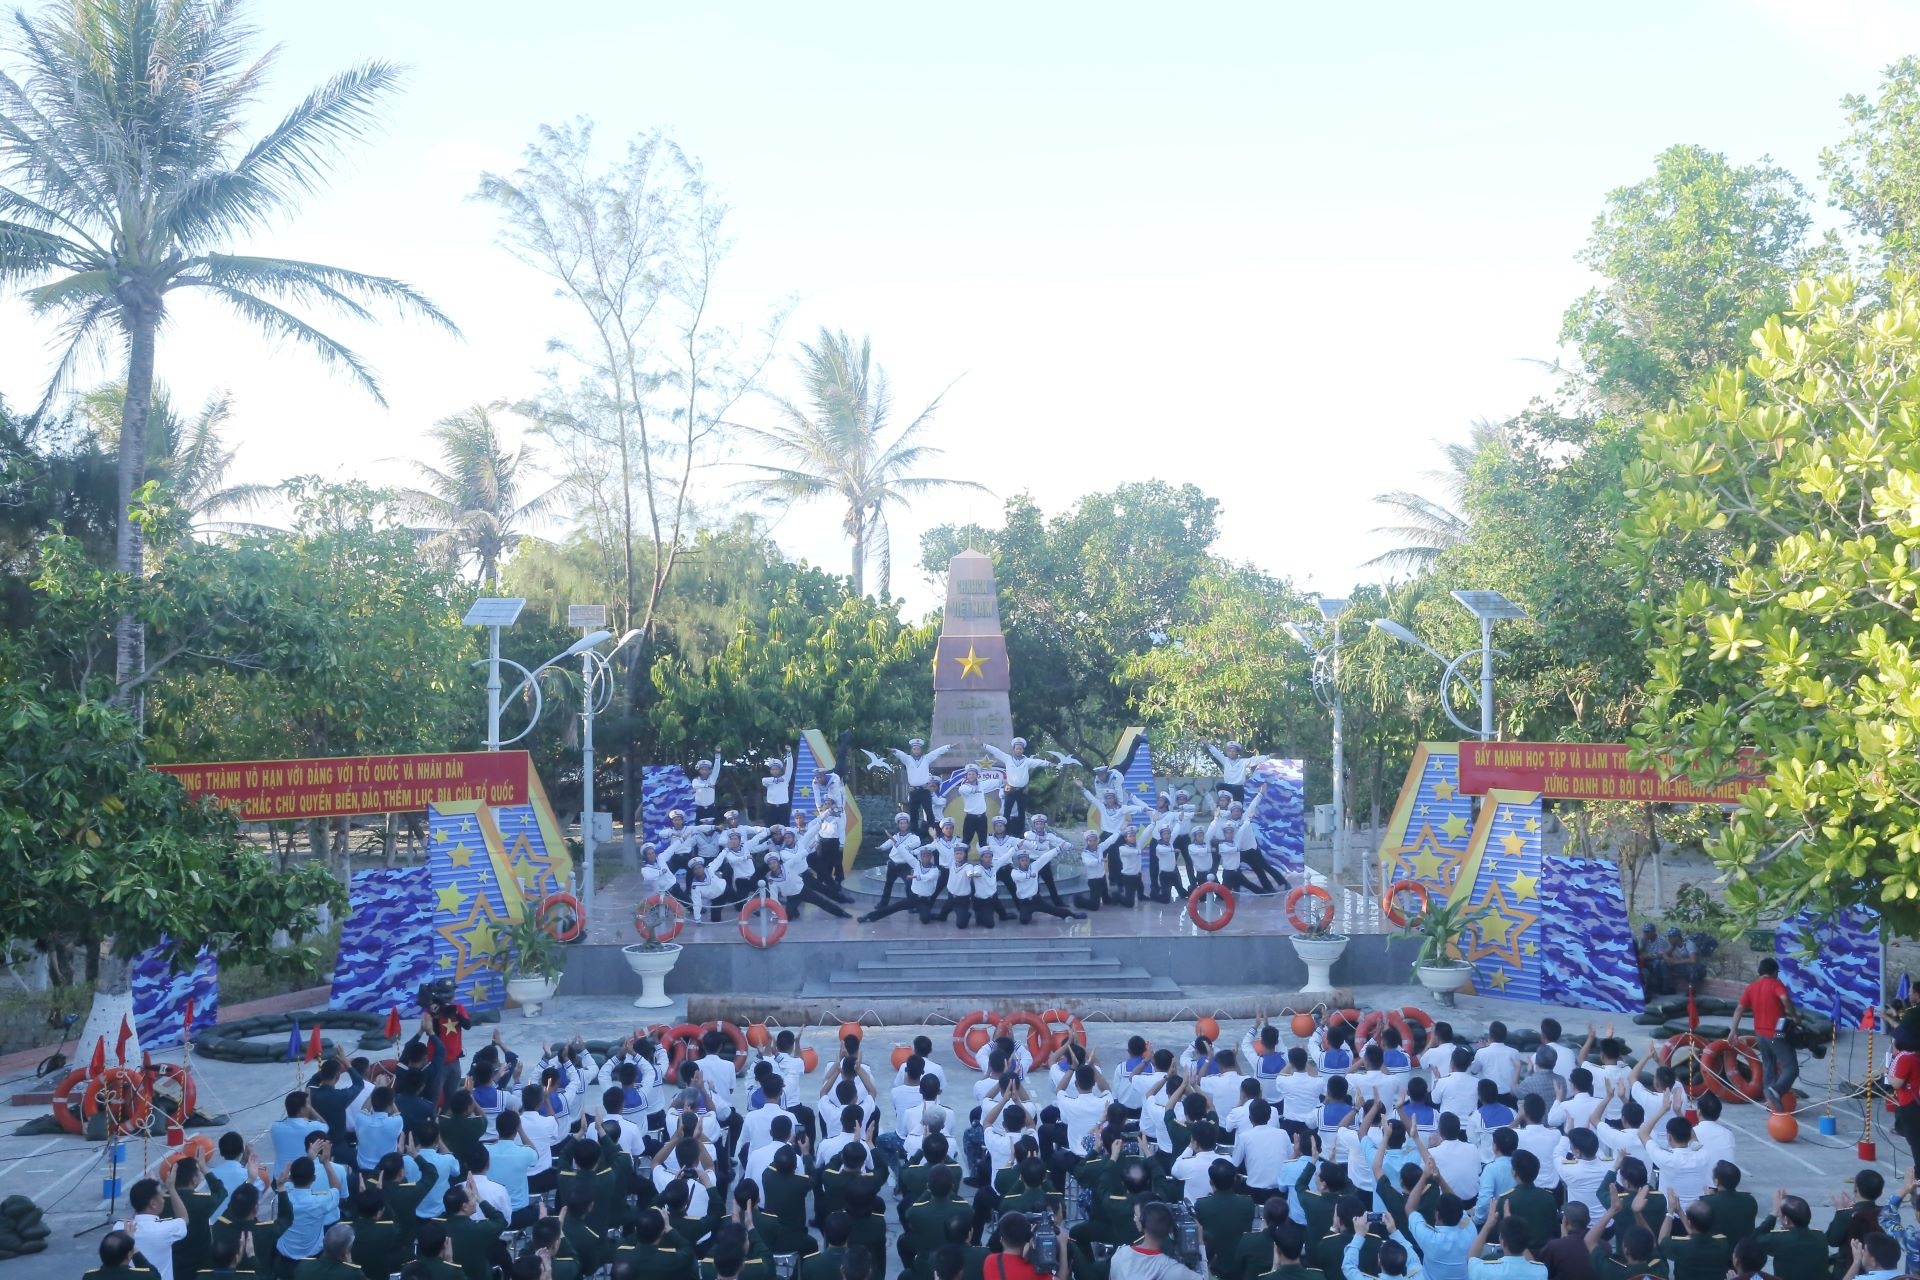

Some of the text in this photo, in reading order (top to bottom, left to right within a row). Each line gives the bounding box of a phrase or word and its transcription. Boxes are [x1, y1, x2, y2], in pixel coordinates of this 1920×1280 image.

[1475, 743, 1491, 766] ĐẨY
[1494, 750, 1522, 770] MẠNH
[1526, 751, 1545, 770] HỌC
[1548, 748, 1567, 771] TẬP
[1570, 748, 1582, 768] VÀ
[1585, 749, 1608, 769] LÀM
[206, 768, 241, 790] THÀNH
[262, 769, 283, 791] HẠN
[287, 764, 303, 787] VỚI
[307, 762, 333, 785] ĐẢNG
[337, 761, 353, 784] VỚI
[357, 758, 370, 782] TỔ
[373, 758, 399, 783] QUỐC
[403, 760, 414, 781] VÀ
[417, 759, 442, 780] NHÂN
[445, 758, 464, 779] DÂN
[1544, 772, 1569, 793] XỨNG
[1572, 777, 1599, 794] DANH
[1602, 775, 1615, 798] BỘ
[1619, 775, 1636, 798] ĐỘI
[1640, 779, 1654, 799] CỤ
[245, 789, 272, 815] CHẮC
[275, 789, 295, 814] CHỦ
[300, 787, 332, 812] QUYỀN
[383, 784, 412, 808] THỀM
[415, 787, 433, 808] LỤC
[491, 777, 514, 801] QUỐC
